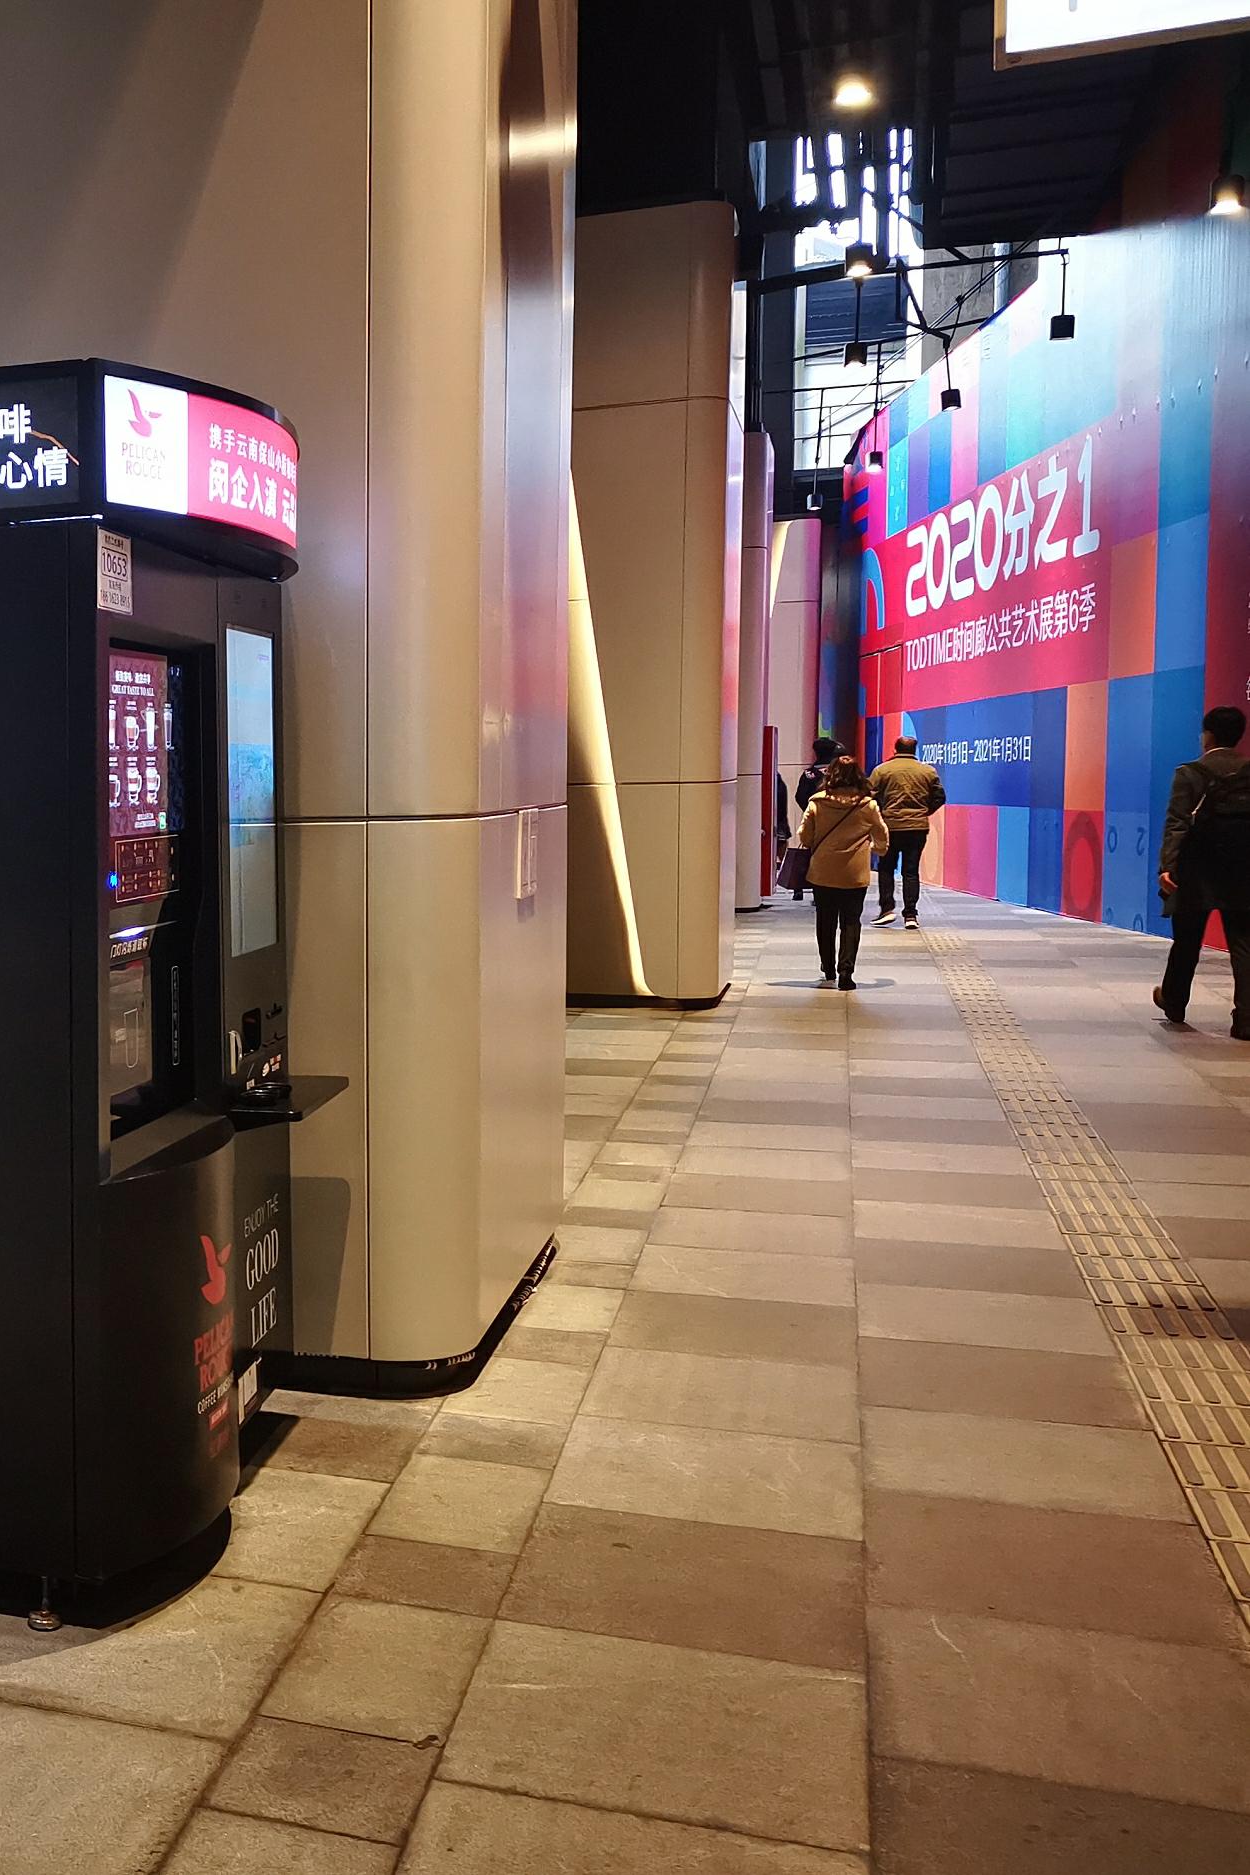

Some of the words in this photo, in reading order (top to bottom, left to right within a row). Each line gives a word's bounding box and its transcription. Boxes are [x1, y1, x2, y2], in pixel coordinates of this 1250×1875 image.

[121, 442, 166, 462] PELICAN
[126, 460, 162, 480] ROUGE
[905, 434, 1100, 618] 2020分之1
[102, 550, 128, 578] 10653
[245, 1205, 265, 1239] ENJOY
[266, 1192, 279, 1215] THE
[246, 1228, 279, 1291] GOOD
[251, 1286, 278, 1349] LIFE
[198, 1388, 217, 1415] COFFEE
